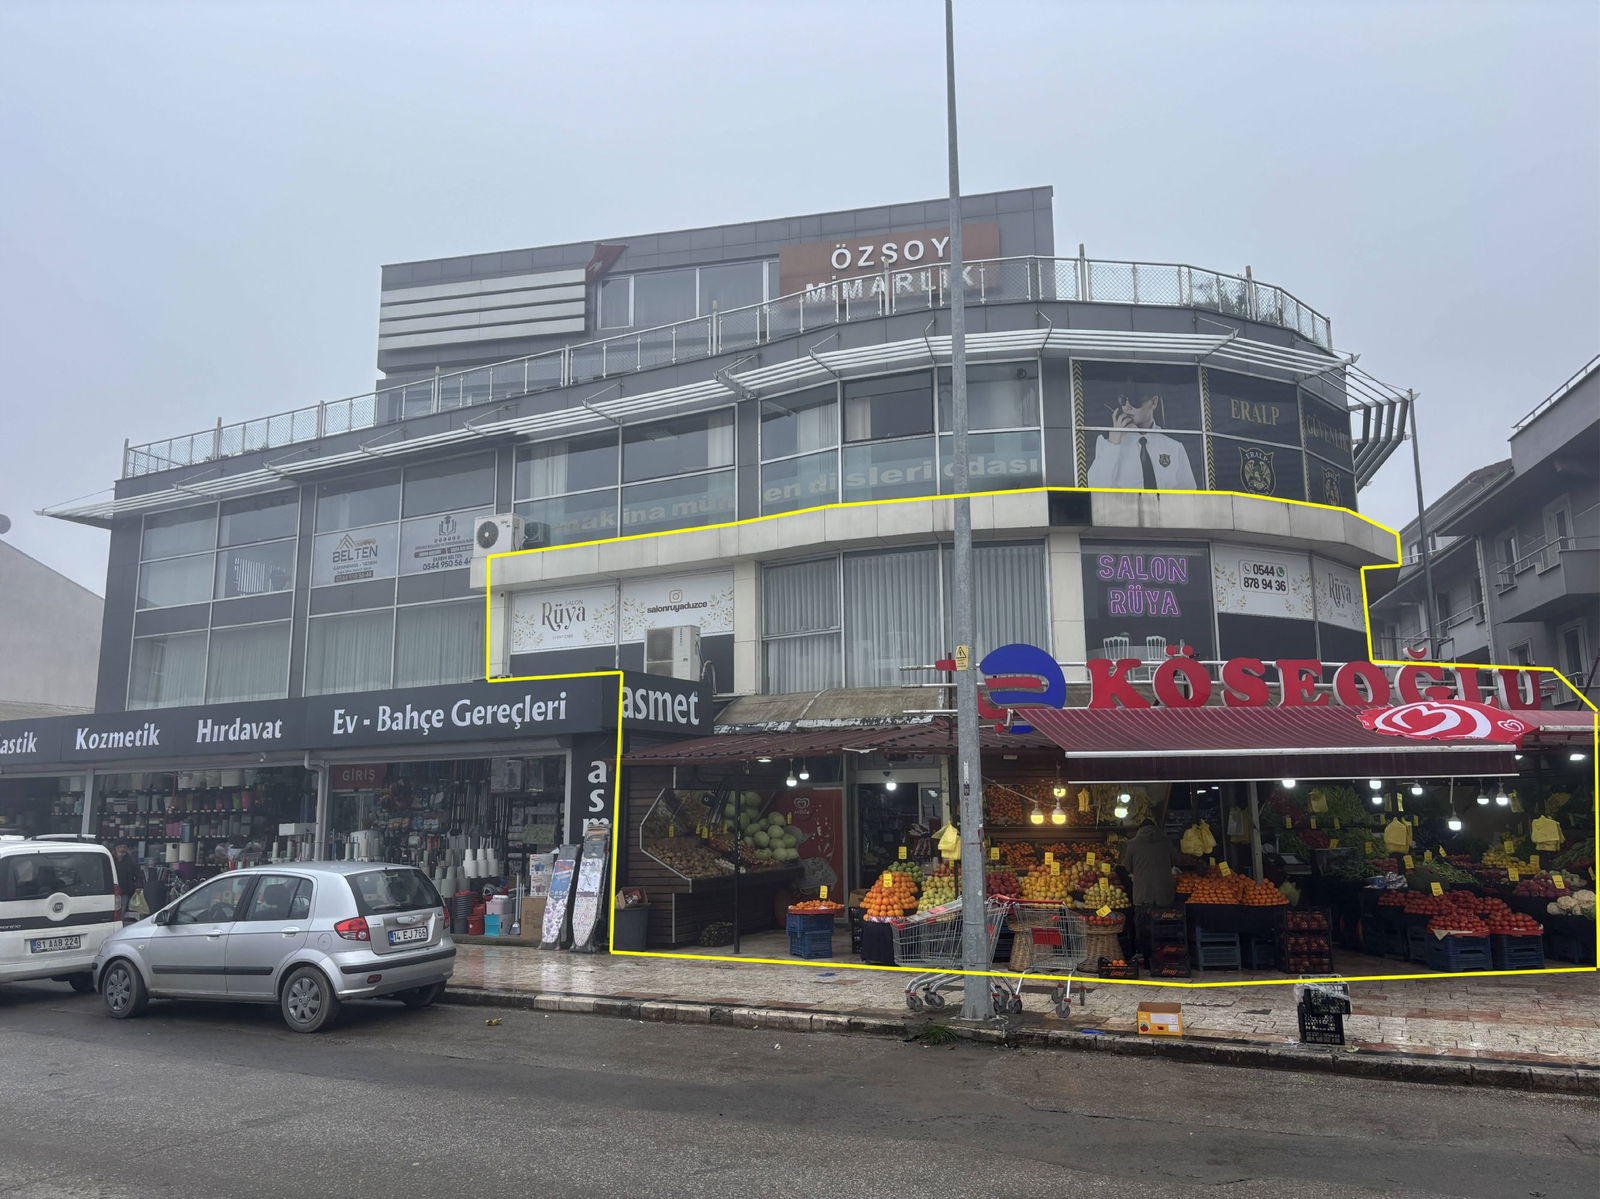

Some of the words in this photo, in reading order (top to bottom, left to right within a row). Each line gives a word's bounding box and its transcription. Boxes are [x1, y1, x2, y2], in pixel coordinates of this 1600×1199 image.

[831, 236, 949, 269] ÖZSOY
[805, 264, 974, 304] MİMARLIK
[1231, 398, 1280, 426] ERALP
[558, 508, 666, 533] makina
[332, 545, 378, 563] BELTEN
[441, 560, 453, 568] 950
[1099, 554, 1187, 582] SALON
[1243, 576, 1260, 589] 878
[1261, 578, 1273, 590] 94
[1274, 580, 1286, 592] 36
[1252, 563, 1275, 577] 0544
[1110, 584, 1179, 615] RÜYA
[1328, 572, 1352, 609] Rüya
[541, 601, 586, 632] Rüya
[647, 601, 708, 613] salonruyaduzce
[1086, 644, 1541, 710] KÖSEOĞLU
[332, 708, 357, 735] Ev
[376, 704, 444, 736] Bahçe
[451, 691, 566, 730] Gereçleri
[75, 722, 160, 751] Kozmetik
[196, 717, 283, 744] Hırdavat
[342, 767, 376, 783] GİRİŞ
[403, 930, 413, 940] EJ
